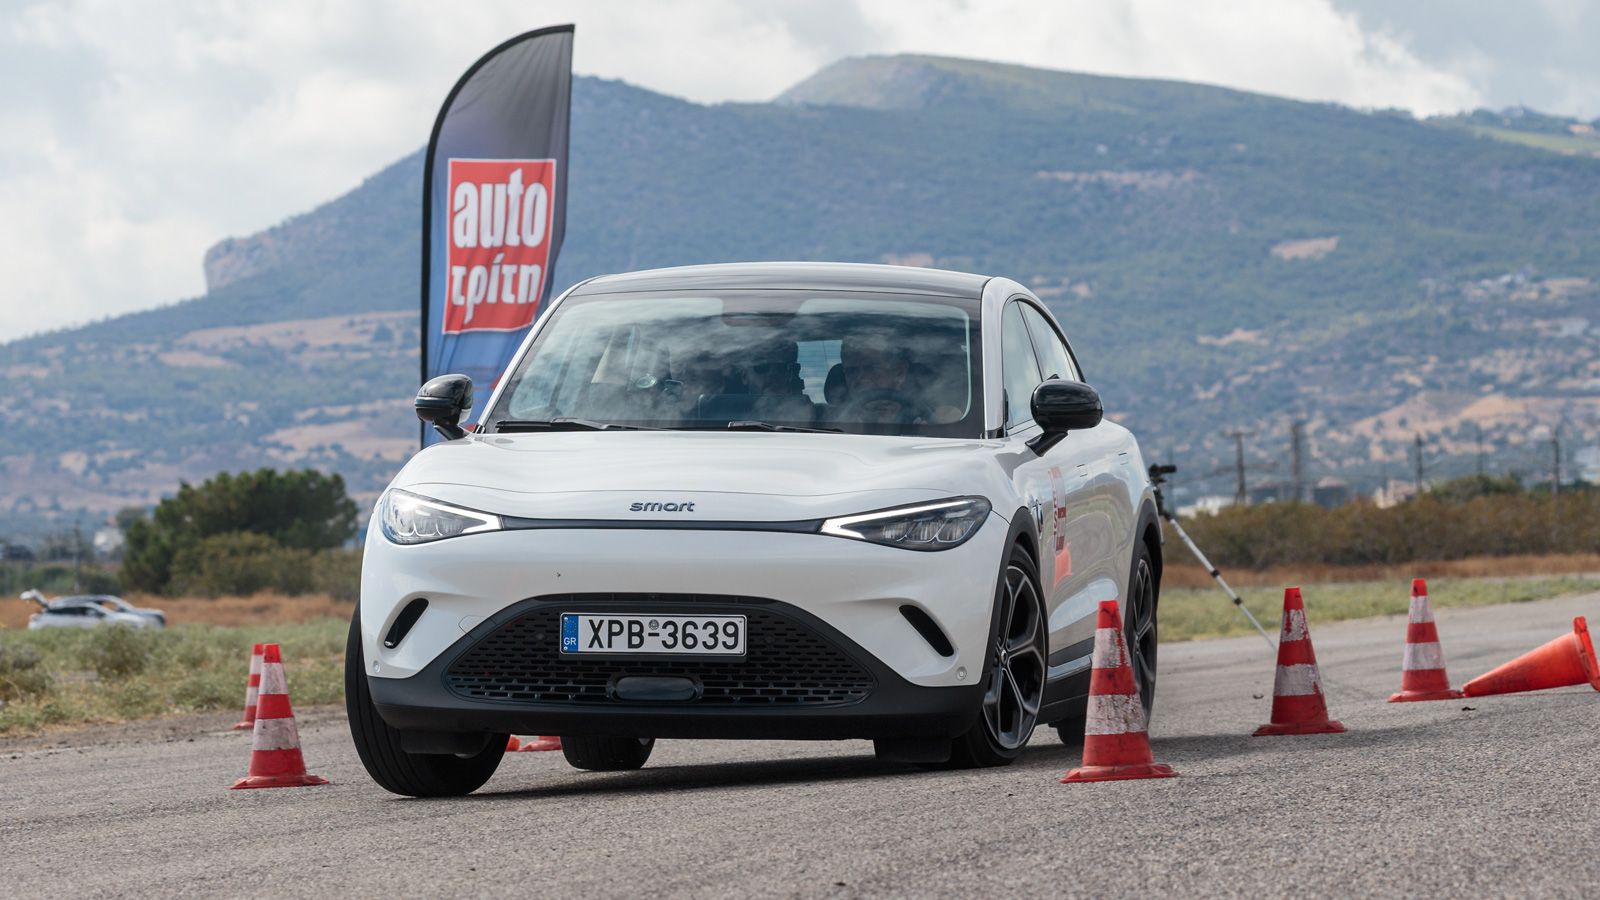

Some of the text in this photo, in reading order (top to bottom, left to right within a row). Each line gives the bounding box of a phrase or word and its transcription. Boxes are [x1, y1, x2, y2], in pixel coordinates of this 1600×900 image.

[453, 167, 549, 249] auto
[629, 502, 695, 512] smart
[563, 637, 577, 646] GR
[588, 619, 739, 650] XPB-3639
